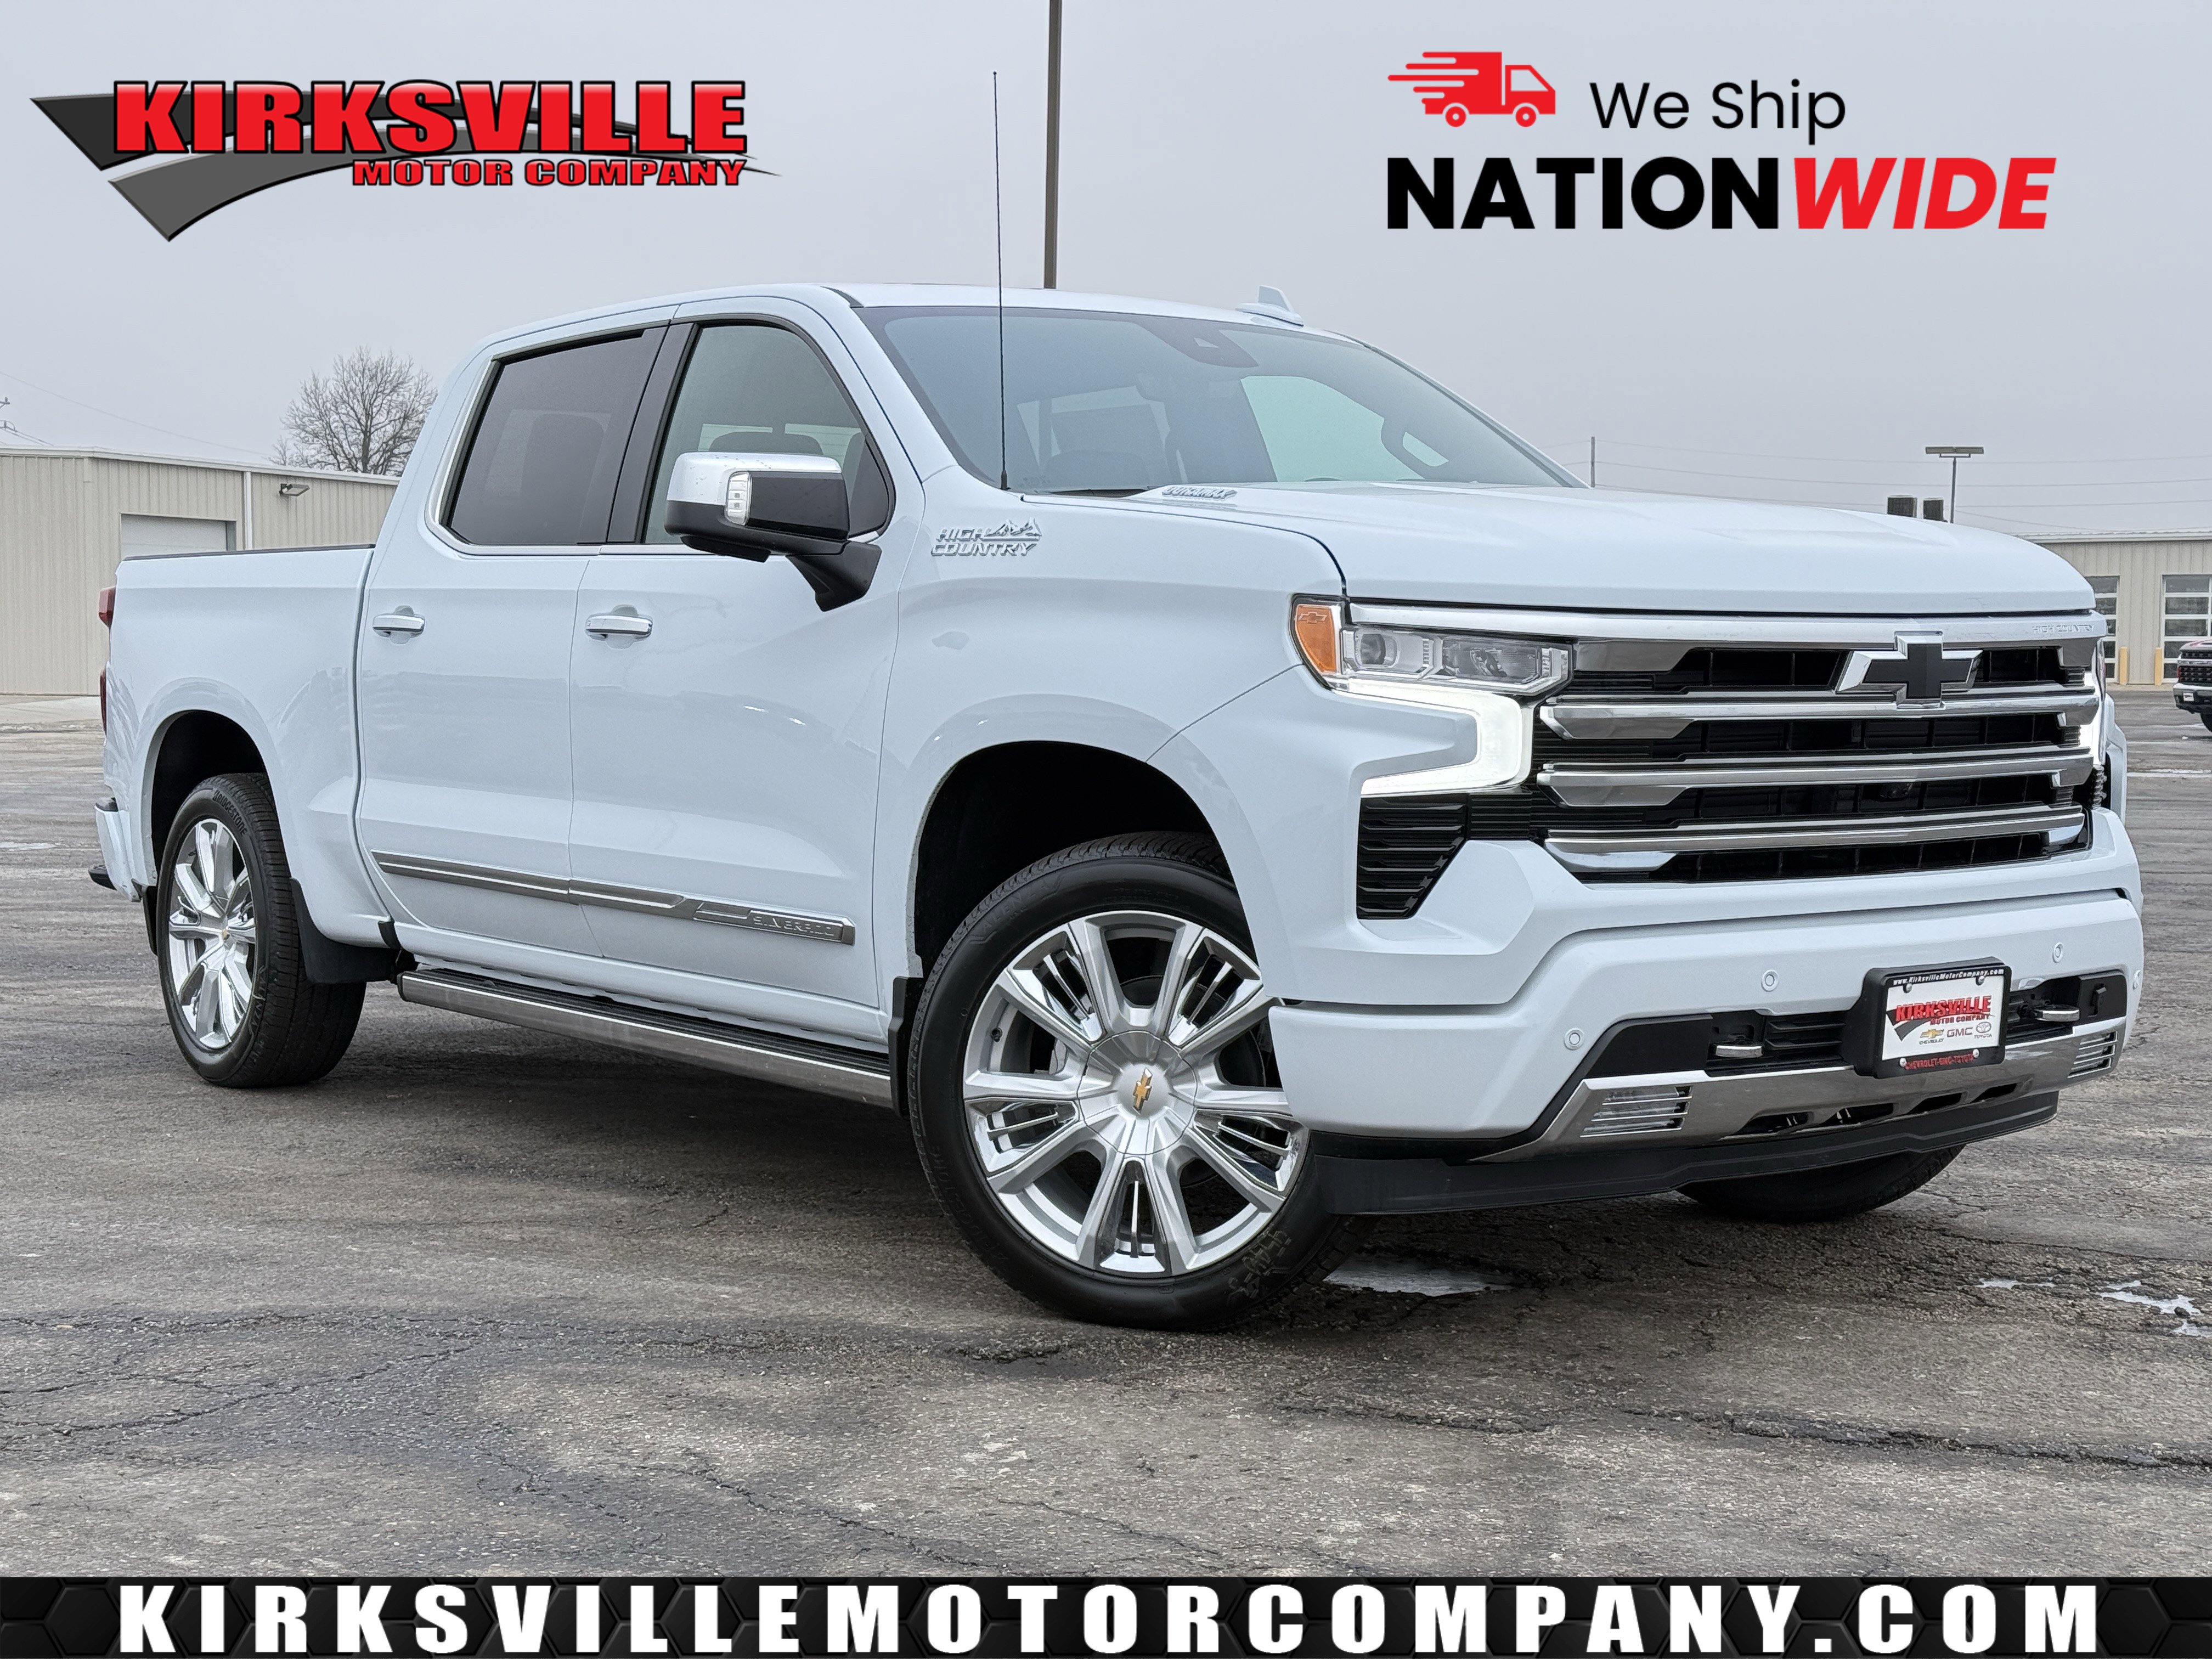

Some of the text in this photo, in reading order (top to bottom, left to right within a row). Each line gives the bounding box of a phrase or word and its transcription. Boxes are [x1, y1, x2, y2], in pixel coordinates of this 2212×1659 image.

[936, 527, 992, 541] HIGH
[931, 542, 1038, 556] COUNTRY
[1893, 968, 2004, 985] www.KirksvilleMotorCompany.com
[1895, 995, 1992, 1023] KIRKSVILLE
[1929, 1013, 1990, 1025] MOTOR COMPANY
[1946, 1027, 1973, 1037] GMC
